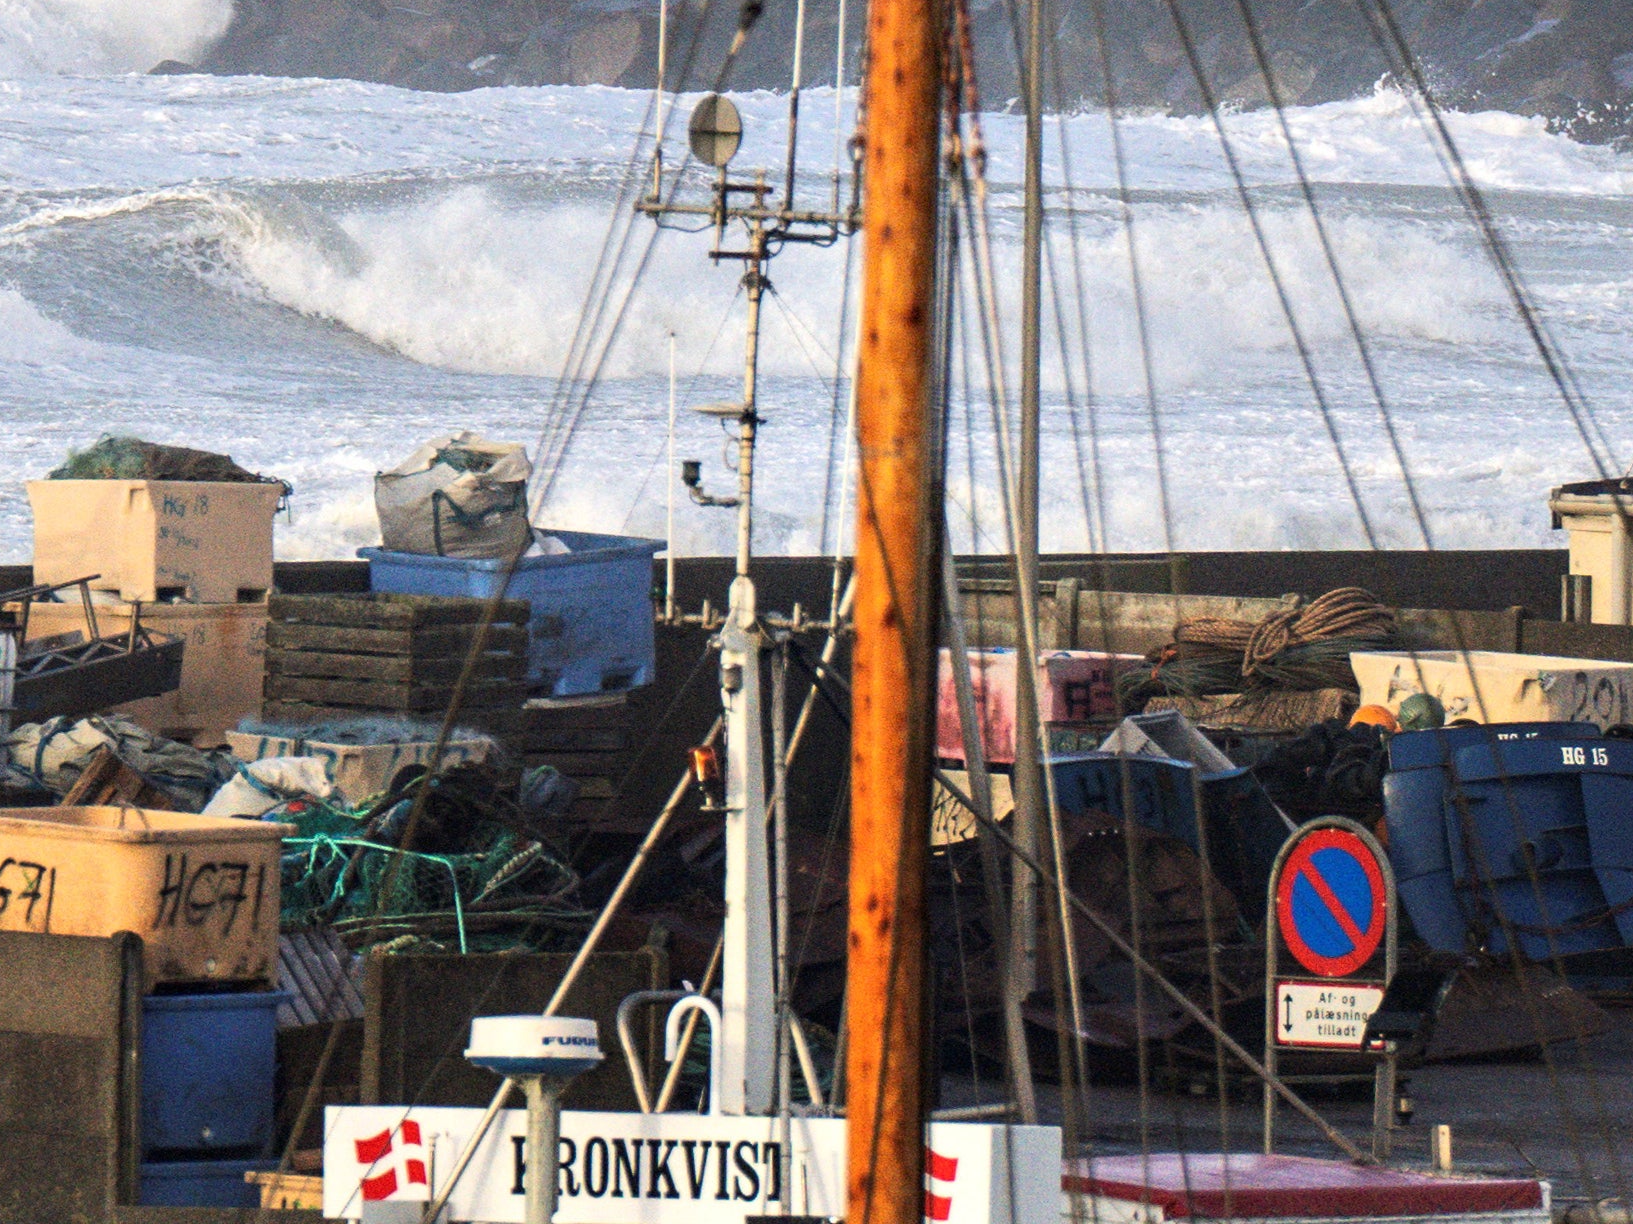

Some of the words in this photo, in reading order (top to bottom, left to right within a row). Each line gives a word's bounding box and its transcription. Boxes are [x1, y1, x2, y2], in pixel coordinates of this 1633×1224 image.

[1561, 747, 1585, 765] HG
[1592, 748, 1608, 766] 15
[153, 853, 265, 937] HG71
[1342, 995, 1356, 1006] og
[1318, 1024, 1356, 1037] tilladt
